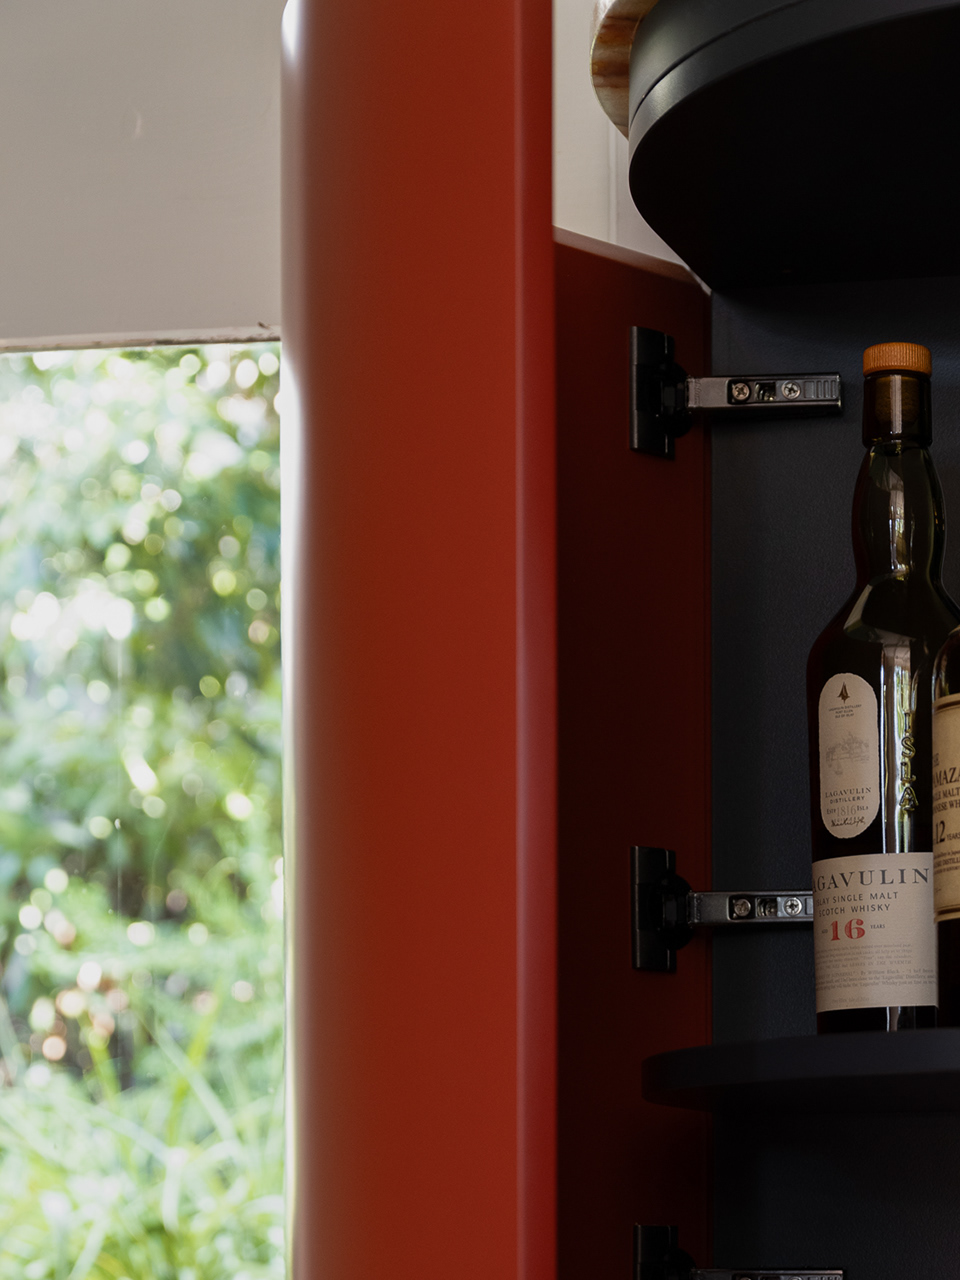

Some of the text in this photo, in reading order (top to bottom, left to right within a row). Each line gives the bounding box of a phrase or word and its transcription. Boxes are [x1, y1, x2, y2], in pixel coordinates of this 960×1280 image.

[825, 787, 871, 798] LAGAVULIN
[943, 787, 960, 798] MALT
[830, 796, 865, 804] DISTILLERY
[837, 806, 856, 816] 1816
[936, 820, 960, 844] 12 YEARS
[833, 894, 864, 904] SINGLE
[870, 892, 898, 900] MALT
[819, 904, 890, 917] SCOTCH WHISKY
[830, 918, 866, 941] 16
